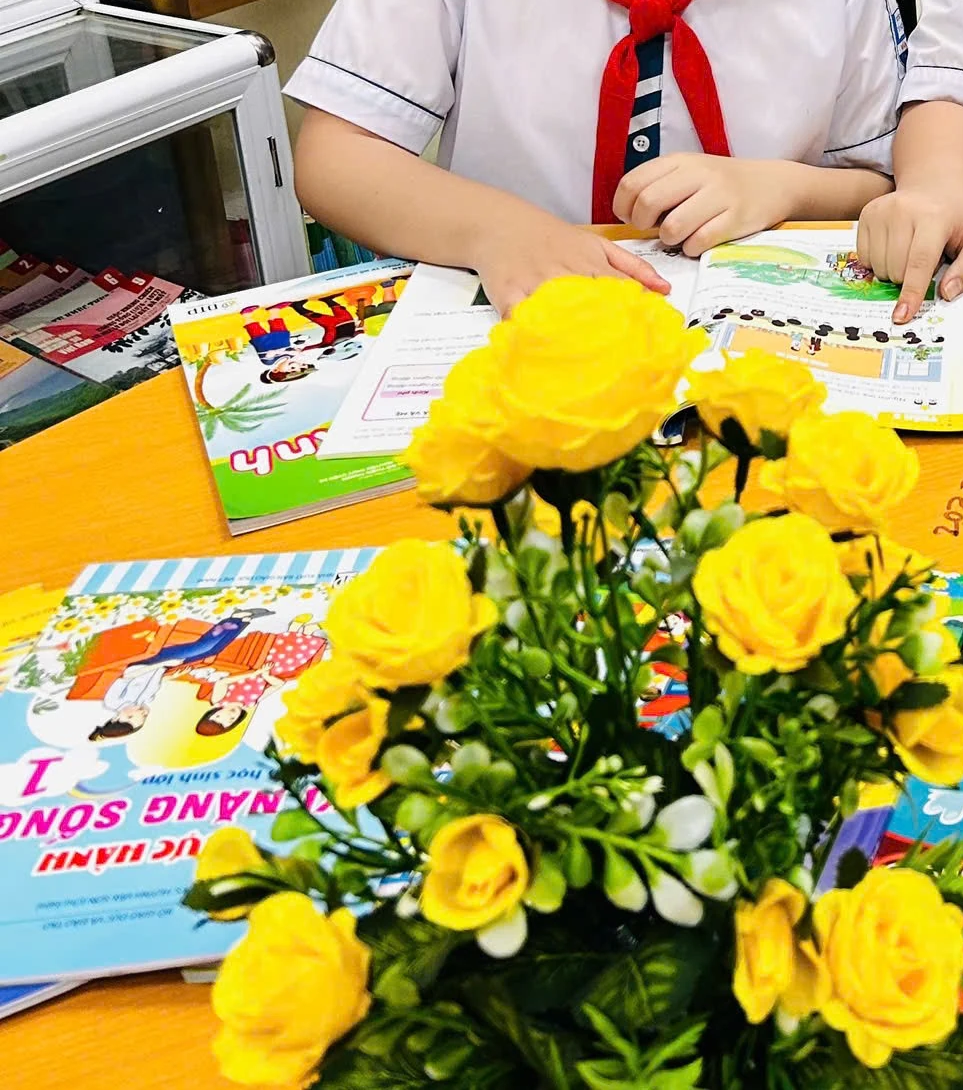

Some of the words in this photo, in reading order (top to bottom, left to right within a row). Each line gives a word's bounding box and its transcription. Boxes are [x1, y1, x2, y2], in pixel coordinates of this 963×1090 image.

[19, 260, 34, 270] 2
[56, 264, 69, 274] 4
[103, 273, 119, 286] 6
[20, 756, 63, 798] 1
[141, 772, 174, 787] lớp
[180, 770, 220, 784] sinh
[224, 766, 262, 781] học
[142, 790, 286, 826] NĂNG
[0, 799, 128, 845] SỐNG
[151, 834, 202, 862] ỰC
[37, 842, 146, 873] HÀNH
